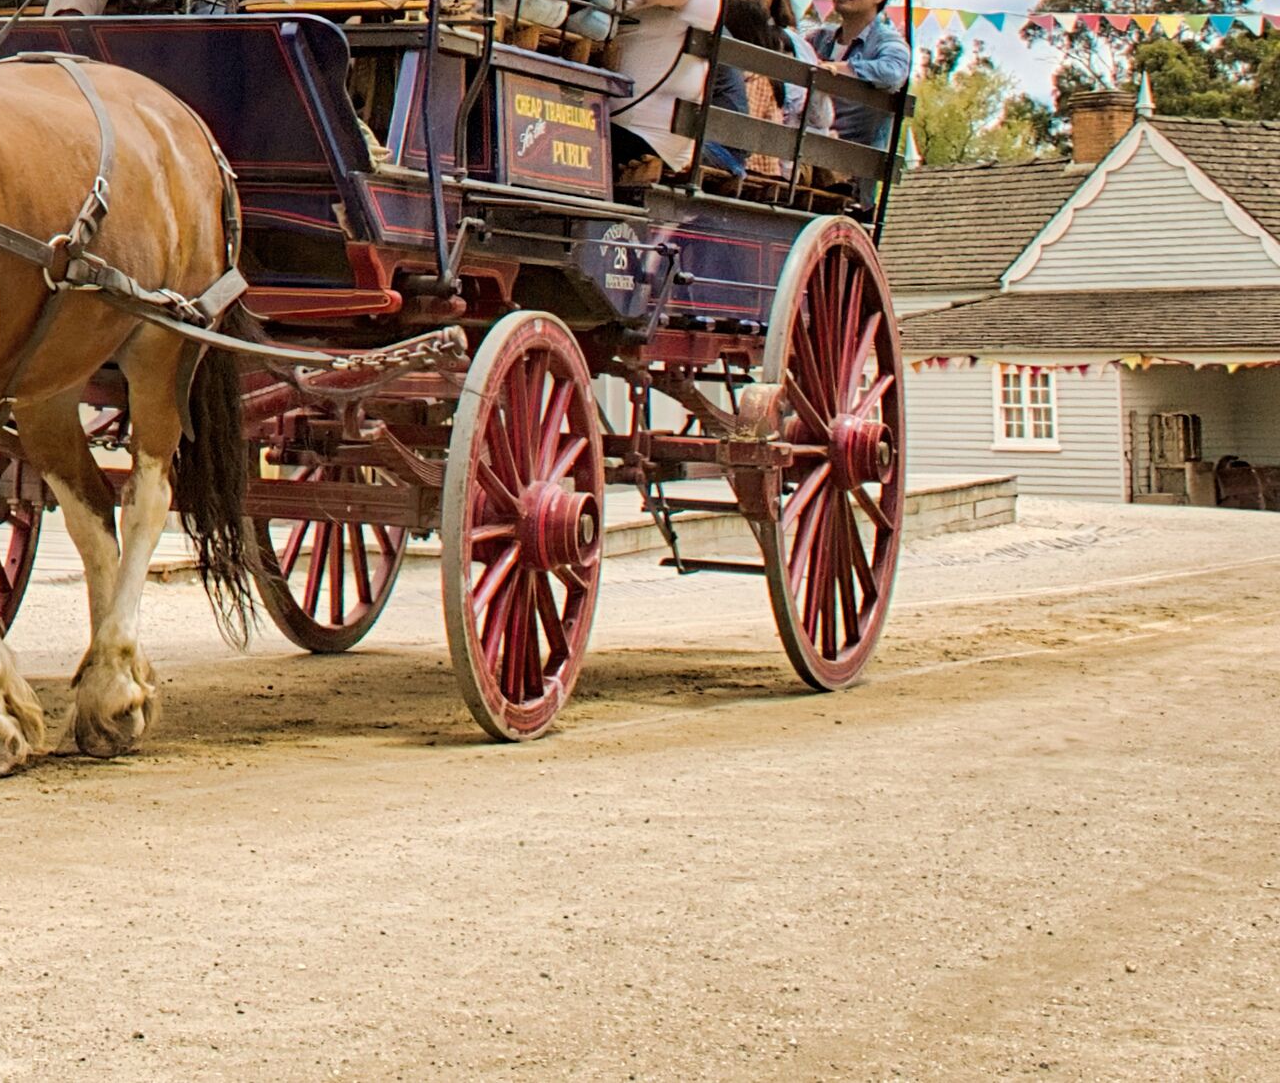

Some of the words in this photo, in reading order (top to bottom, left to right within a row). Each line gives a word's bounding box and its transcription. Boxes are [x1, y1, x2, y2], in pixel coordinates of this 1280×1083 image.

[515, 94, 542, 119] CHEAP
[543, 100, 596, 131] TRAVELLING
[552, 140, 592, 170] PUBLIC
[613, 246, 628, 270] 28
